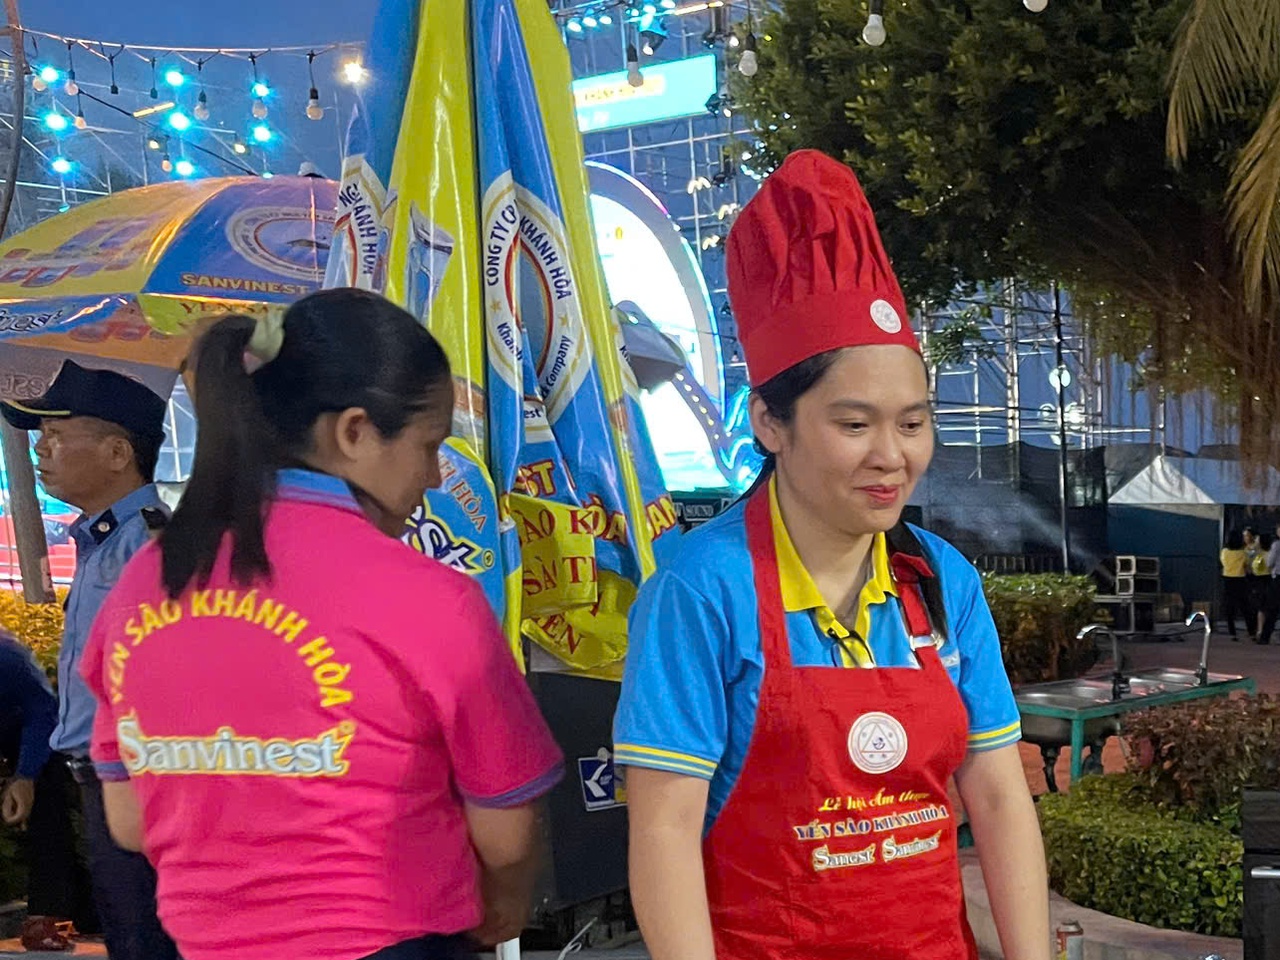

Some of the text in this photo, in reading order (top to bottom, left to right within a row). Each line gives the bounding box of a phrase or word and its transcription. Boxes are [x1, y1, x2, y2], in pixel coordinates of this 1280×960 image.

[491, 220, 510, 242] TY
[519, 215, 573, 300] KHÁNH HÒA
[181, 273, 311, 295] SANVINEST
[546, 335, 575, 387] Company
[451, 481, 488, 534] HÒA
[190, 588, 310, 643] KHÁNH
[297, 636, 354, 708] HÒA
[117, 716, 349, 776] Sanvinest
[835, 817, 870, 836] SÀO
